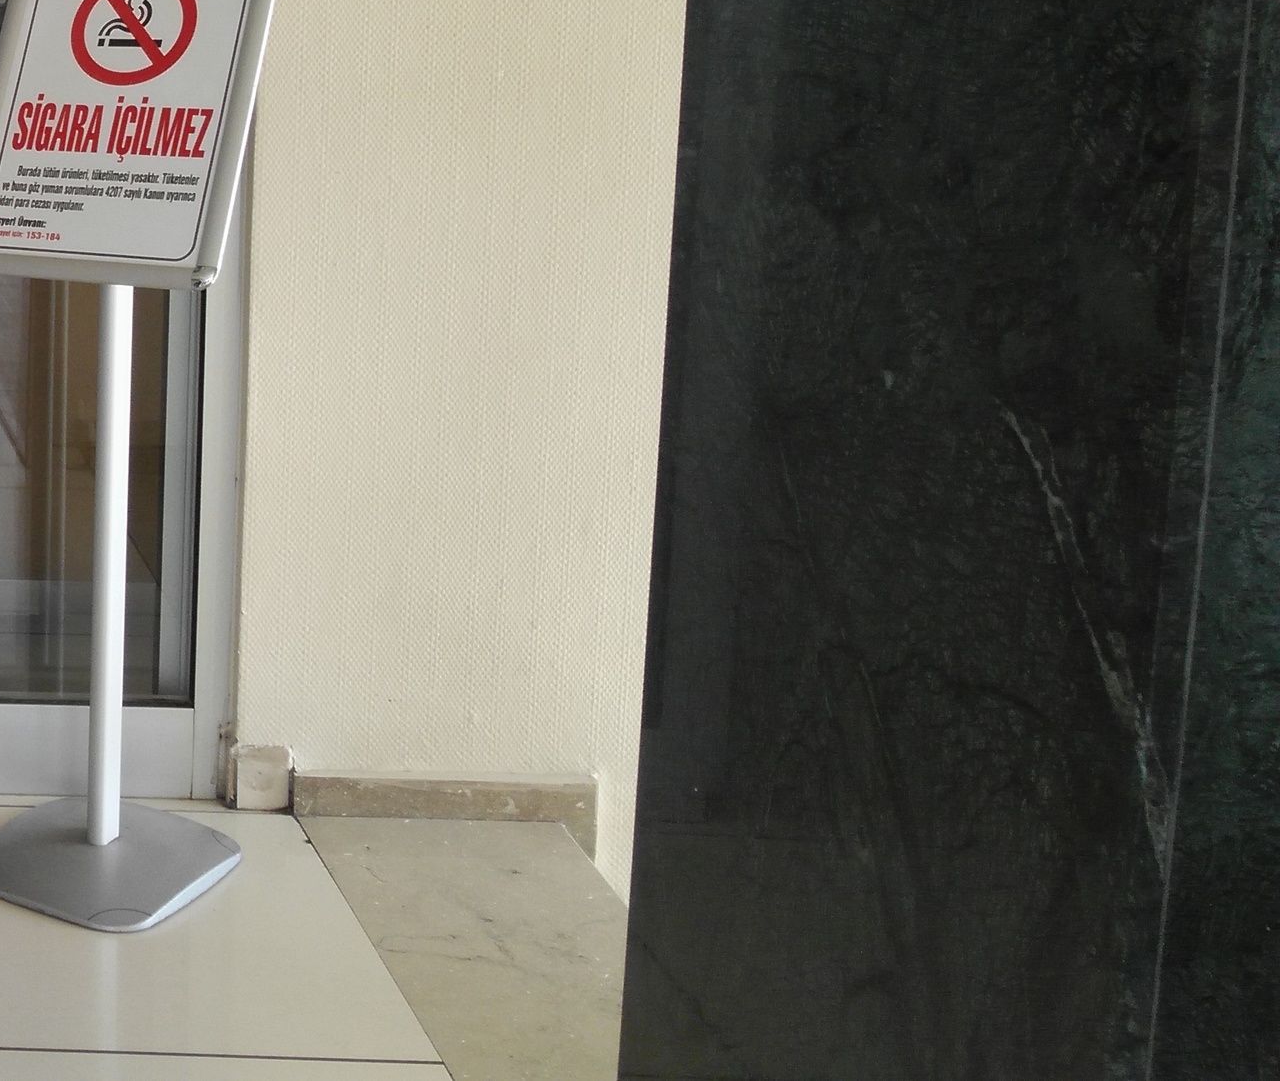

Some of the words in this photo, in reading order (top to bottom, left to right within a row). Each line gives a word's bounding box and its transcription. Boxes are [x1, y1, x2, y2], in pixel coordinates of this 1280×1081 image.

[11, 94, 105, 154] SİGARA
[106, 96, 215, 163] İÇİLMEZ
[17, 165, 41, 177] Burada
[105, 186, 124, 198] 4207
[26, 231, 61, 241] 153-184
